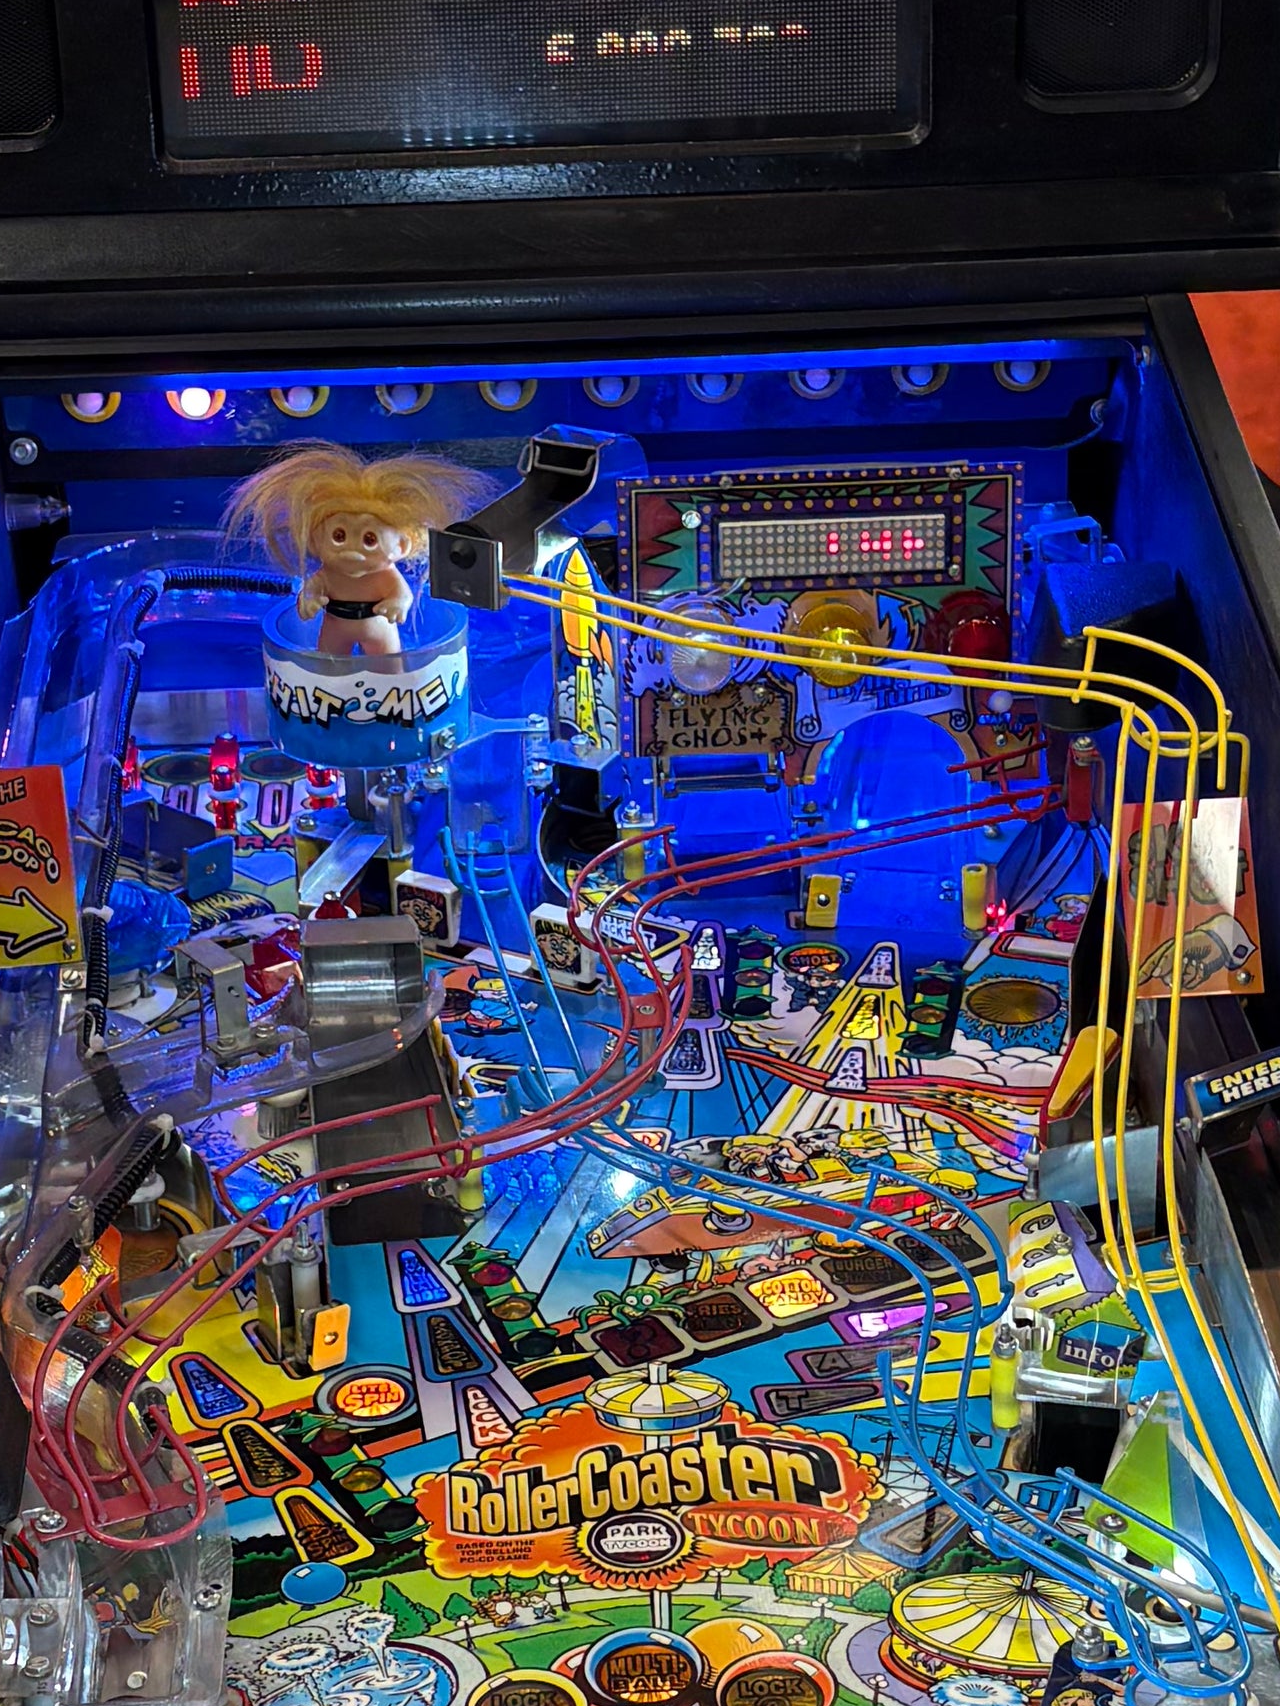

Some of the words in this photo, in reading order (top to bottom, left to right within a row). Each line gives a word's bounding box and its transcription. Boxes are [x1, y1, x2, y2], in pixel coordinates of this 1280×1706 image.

[270, 669, 345, 729] HIT
[669, 706, 771, 728] FLYING
[762, 1278, 822, 1295] COTTON
[1063, 1337, 1116, 1369] info
[349, 1382, 390, 1394] LITE
[340, 1392, 405, 1410] SPIN
[450, 1429, 815, 1535] RollerCoaster
[610, 1524, 664, 1538] PARK
[686, 1511, 820, 1544] TYCOON
[456, 1542, 494, 1550] BASED
[485, 1547, 532, 1555] SELLING
[605, 1537, 671, 1552] TYCOON
[459, 1556, 495, 1564] PC-CD
[611, 1674, 685, 1693] BALL
[737, 1677, 803, 1697] LOCK
